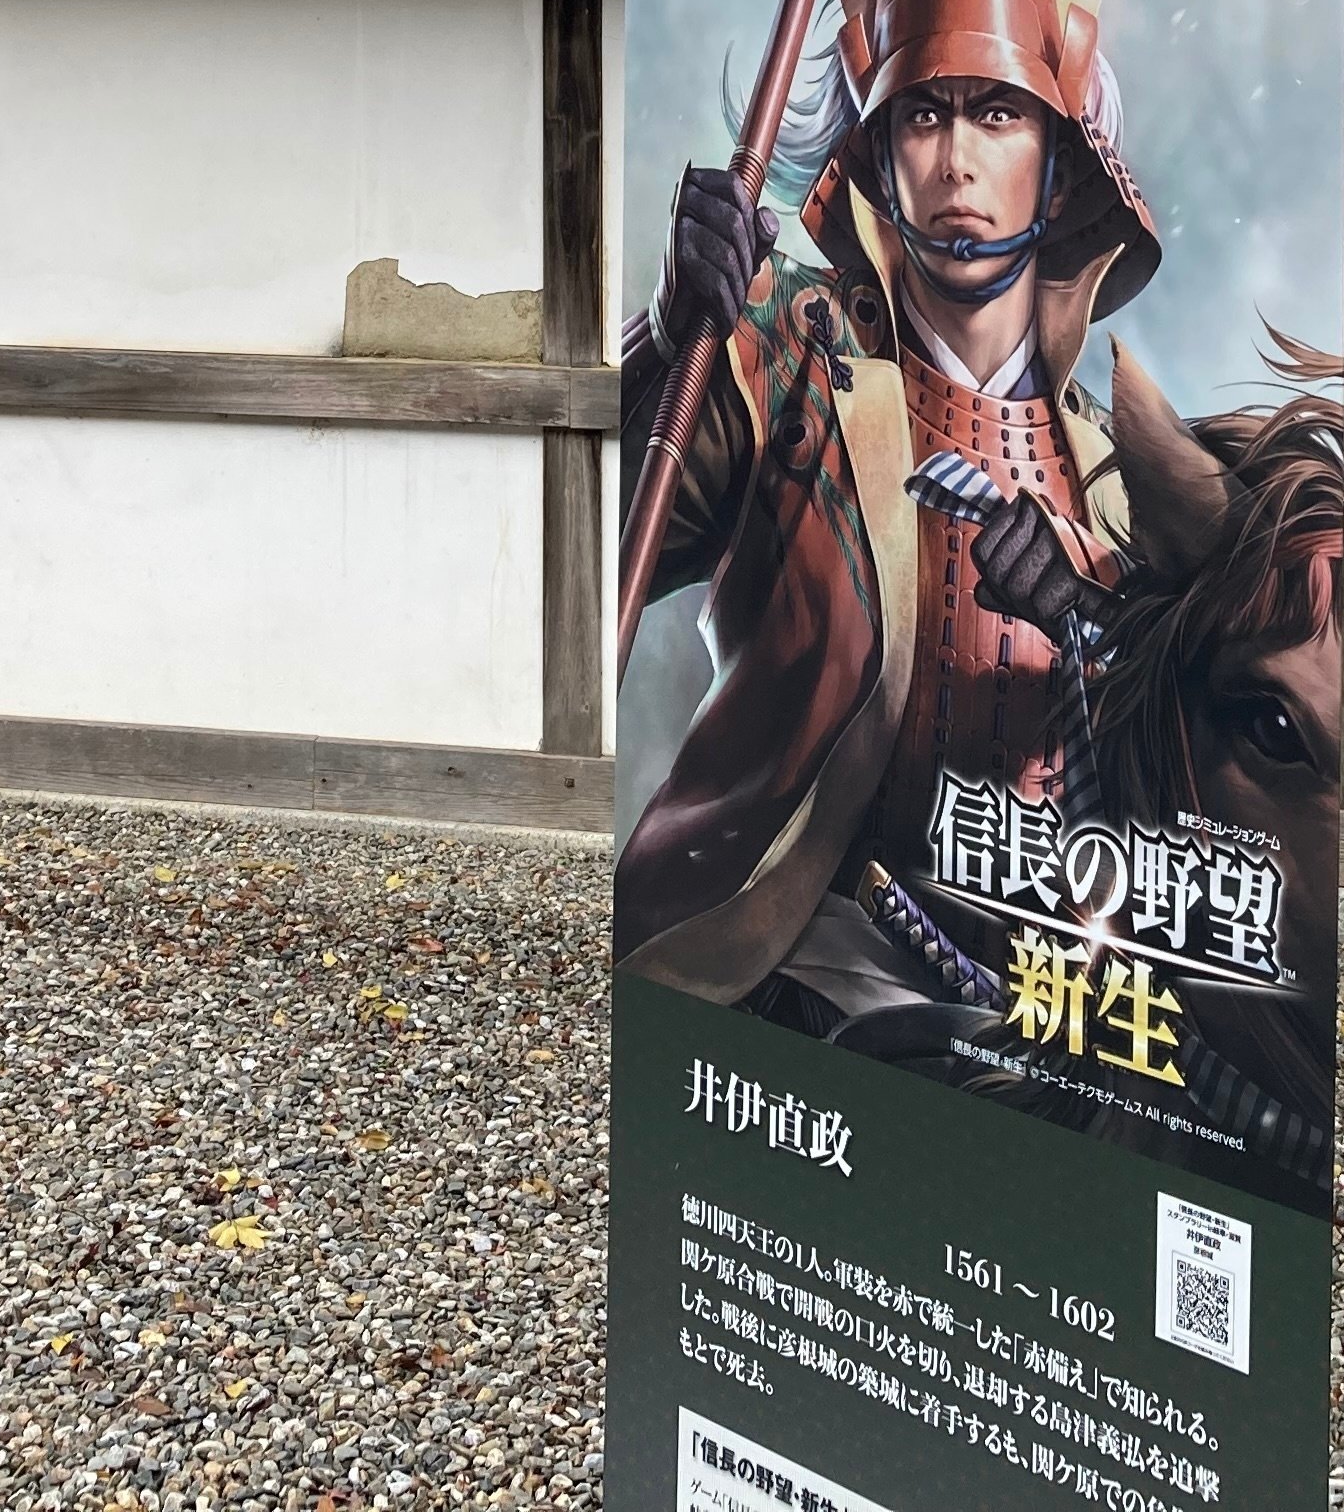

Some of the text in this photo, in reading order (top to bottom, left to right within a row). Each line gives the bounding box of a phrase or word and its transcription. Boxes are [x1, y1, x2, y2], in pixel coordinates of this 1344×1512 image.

[933, 778, 1278, 976] 信長の野望
[1177, 811, 1281, 850] 歴史シミュレーションゲーム
[1006, 925, 1186, 1088] 新生
[684, 1058, 853, 1177] 井伊直政
[1145, 1105, 1160, 1123] All
[1163, 1112, 1193, 1134] rights
[1195, 1124, 1247, 1153] reserved.
[944, 1243, 1003, 1297] 1561
[1049, 1286, 1116, 1342] 1602
[680, 1326, 774, 1396] もとで死去。
